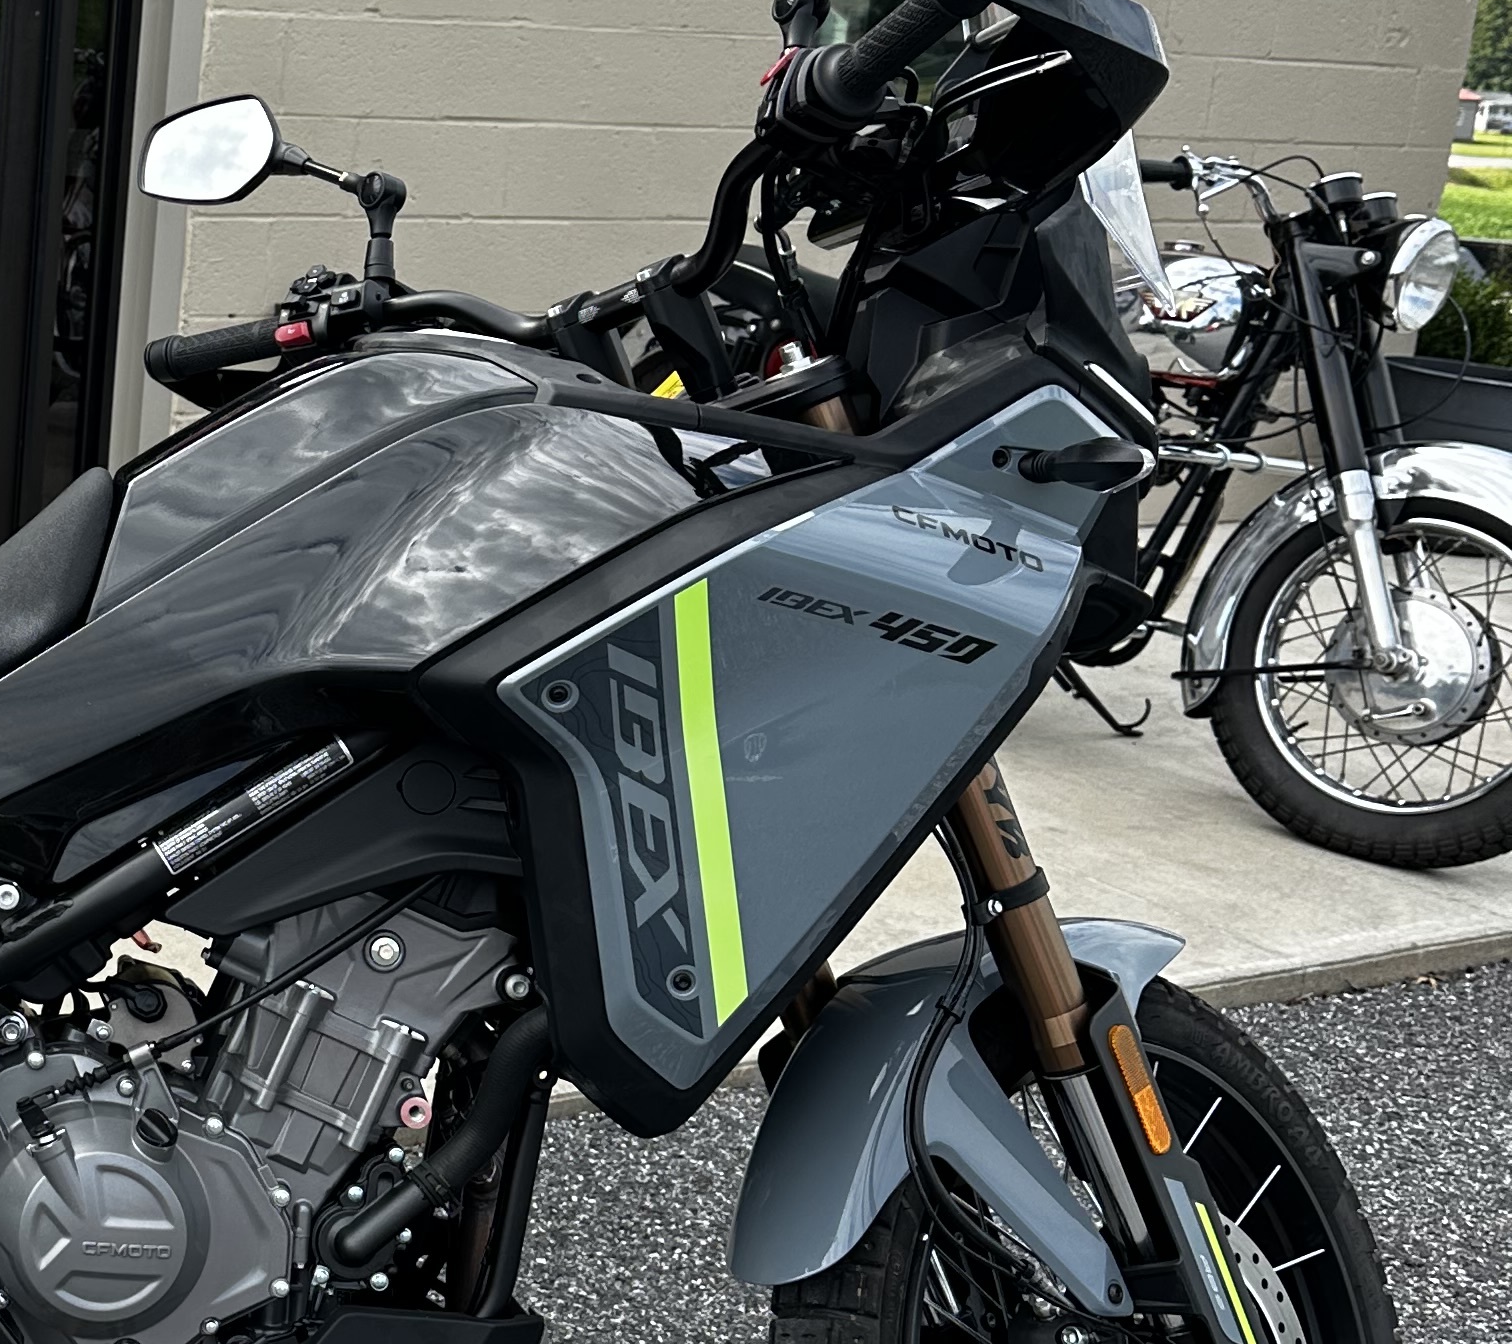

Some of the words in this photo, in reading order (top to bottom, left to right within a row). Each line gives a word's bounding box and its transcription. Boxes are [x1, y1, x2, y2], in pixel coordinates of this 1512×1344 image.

[892, 504, 1044, 574] CFMOTO
[758, 587, 868, 628] IBEX
[869, 611, 999, 665] 450
[607, 642, 686, 952] IBEX
[81, 1240, 172, 1259] CFMOTO
